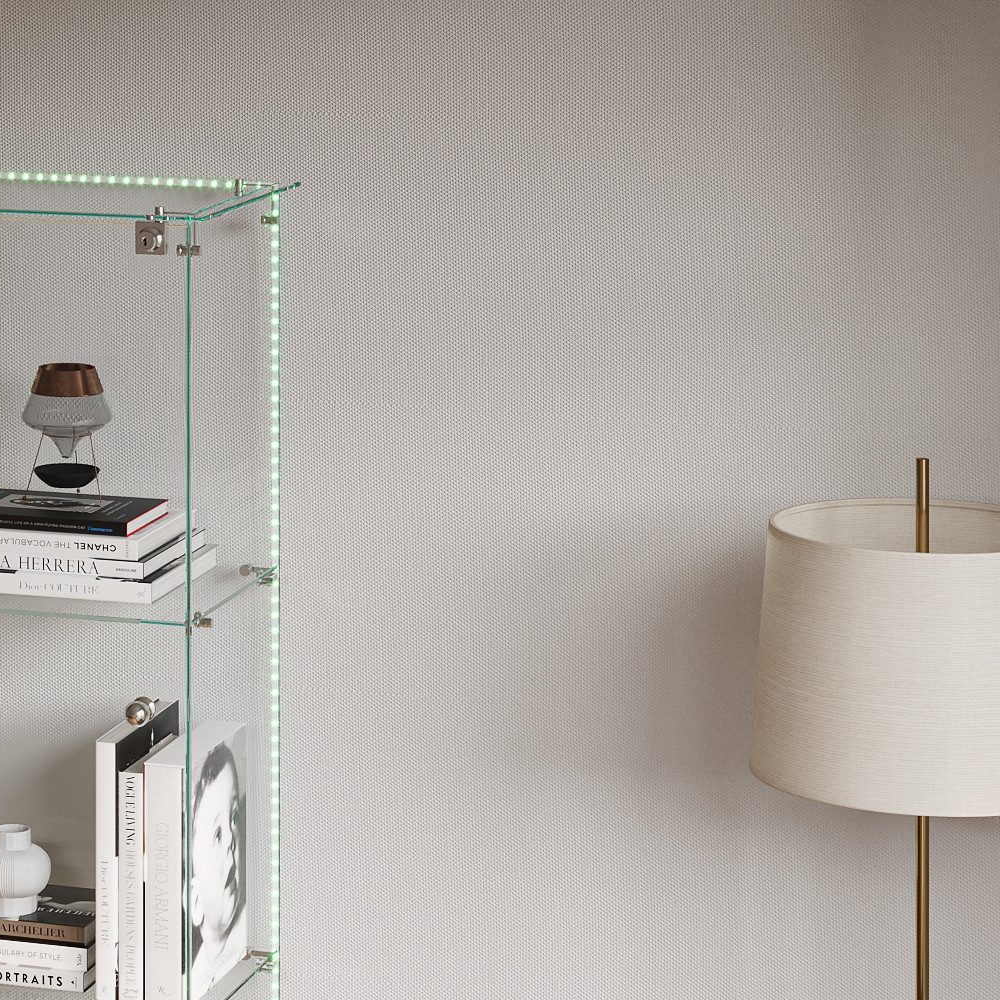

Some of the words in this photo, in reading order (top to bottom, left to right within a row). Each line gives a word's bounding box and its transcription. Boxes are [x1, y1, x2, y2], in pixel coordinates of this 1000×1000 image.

[54, 541, 70, 549] THE
[73, 542, 117, 552] CHANEL
[18, 556, 99, 575] HERRERA
[125, 810, 136, 846] LIVING
[155, 822, 169, 884] GIORGIO
[155, 886, 169, 950] ARMANI
[40, 952, 61, 961] STYLE
